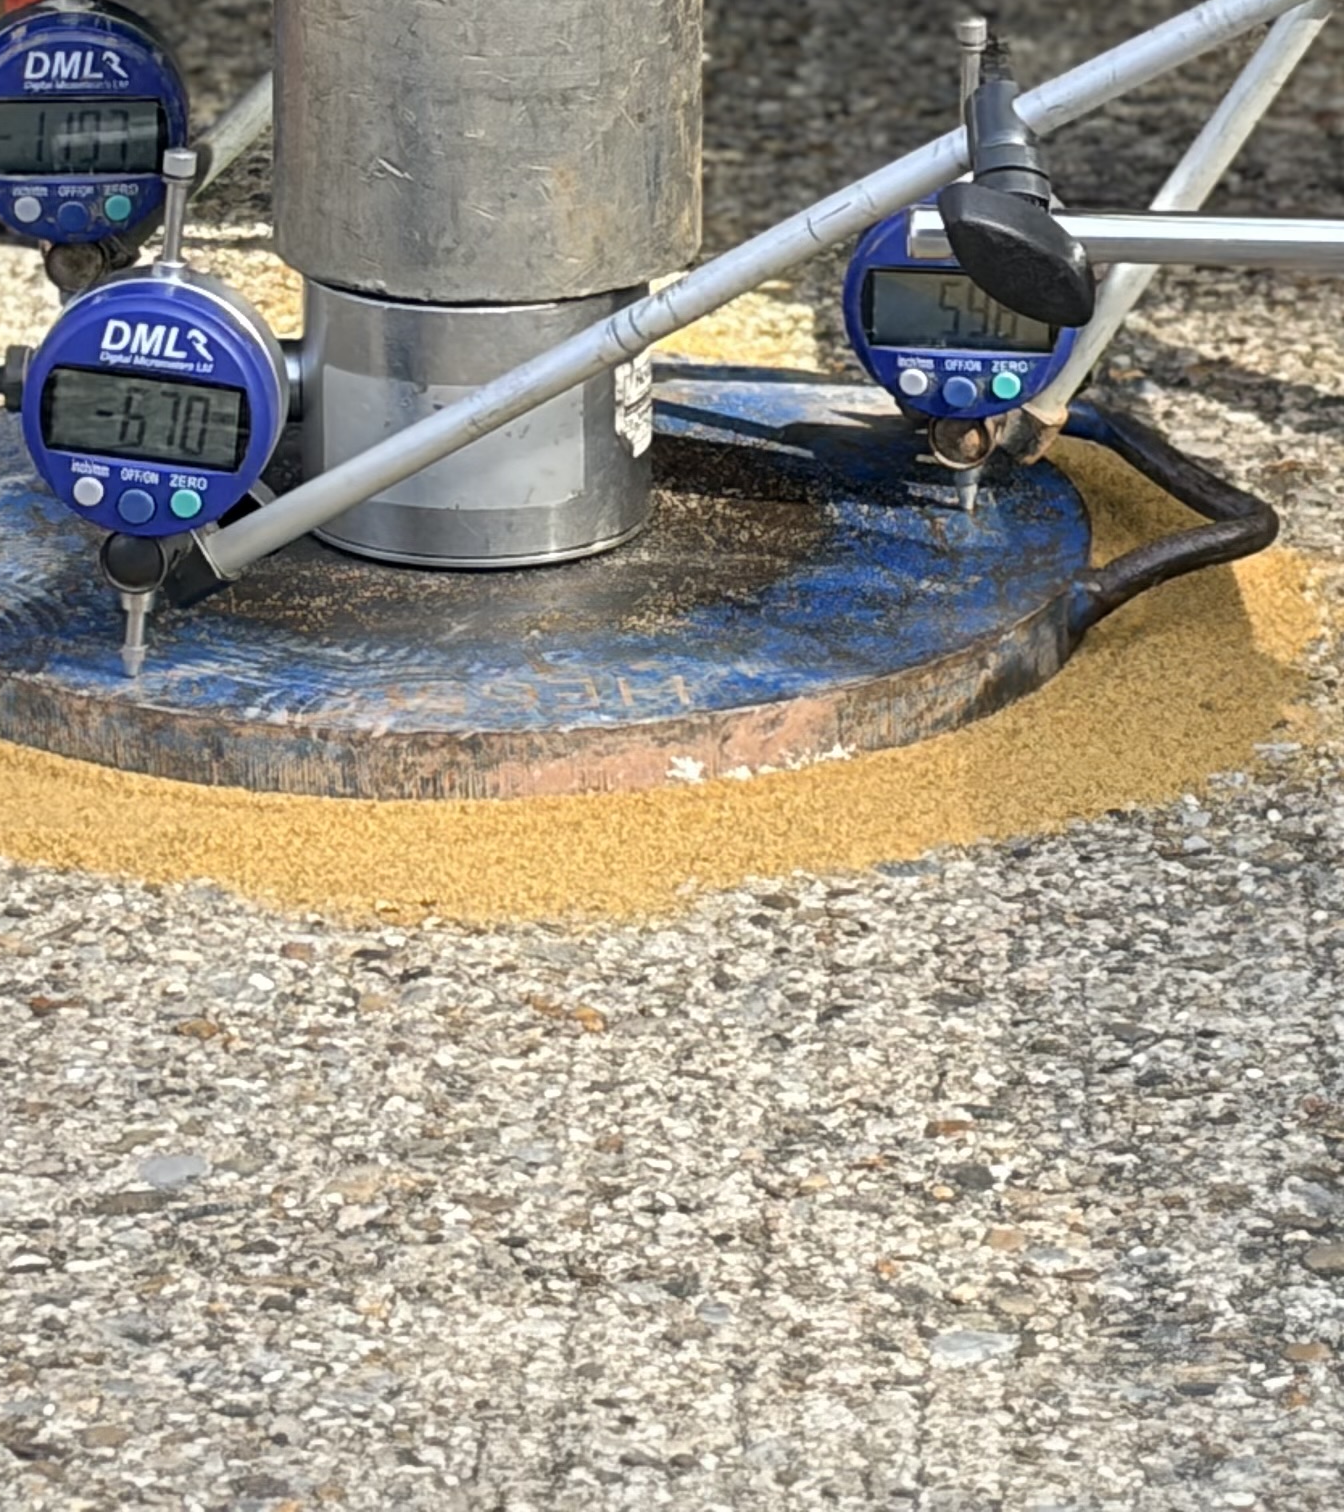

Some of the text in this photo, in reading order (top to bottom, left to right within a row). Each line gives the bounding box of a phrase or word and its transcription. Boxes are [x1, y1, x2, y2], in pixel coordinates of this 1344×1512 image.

[24, 50, 104, 80] DML
[101, 318, 188, 359] DML
[991, 359, 1029, 374] ZERO
[168, 473, 209, 491] ZERO
